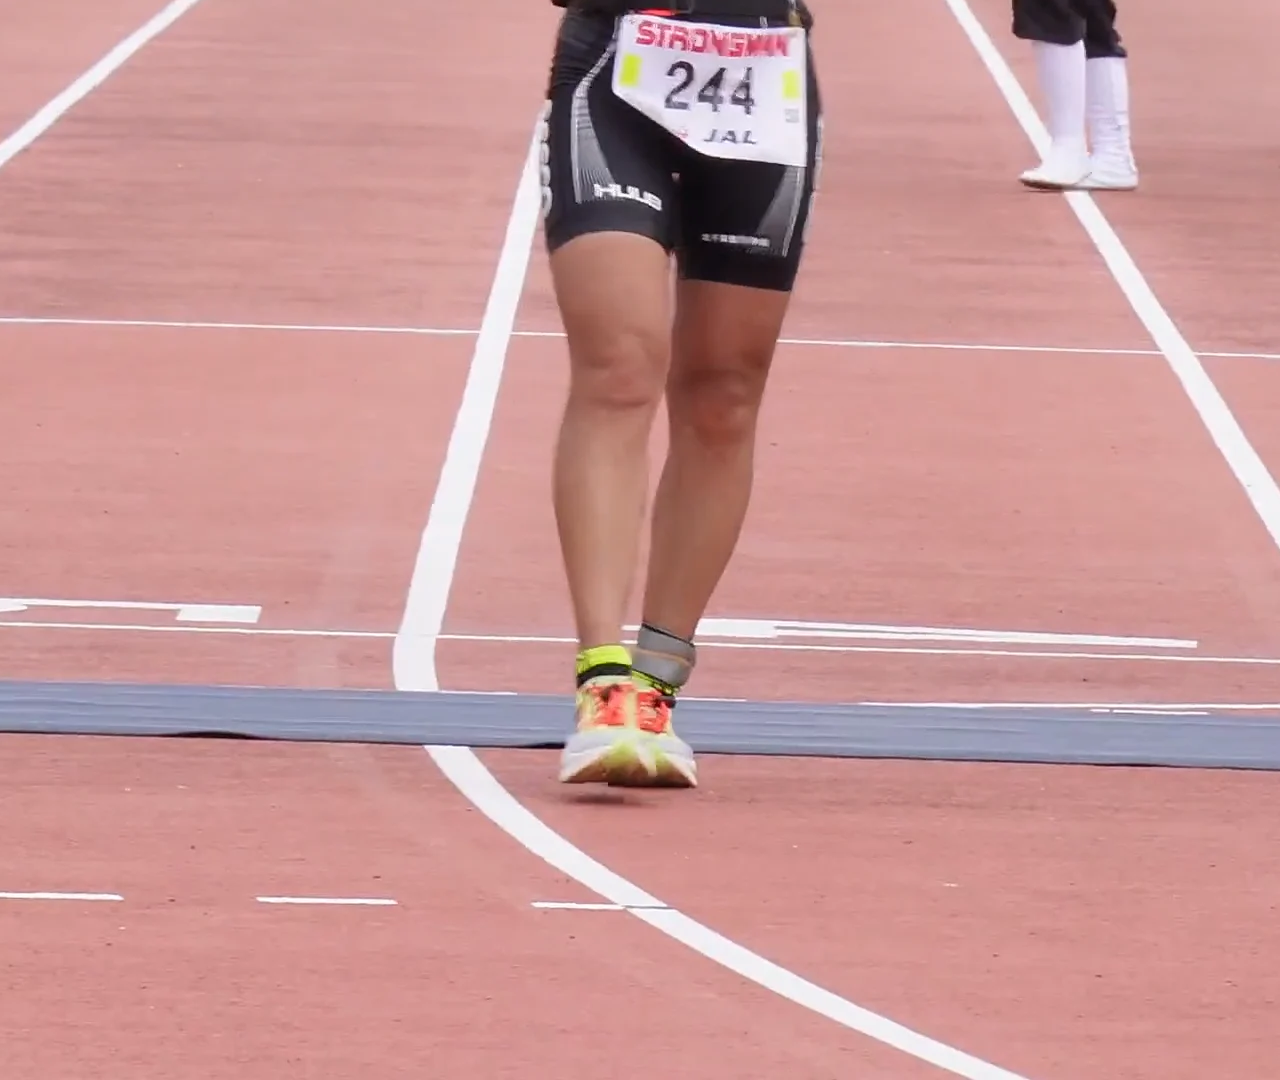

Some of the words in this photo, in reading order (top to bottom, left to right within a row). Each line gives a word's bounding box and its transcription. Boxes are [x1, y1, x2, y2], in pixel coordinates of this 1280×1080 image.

[634, 19, 792, 58] STRONGMAN
[664, 60, 756, 115] 244
[703, 128, 757, 145] JAL
